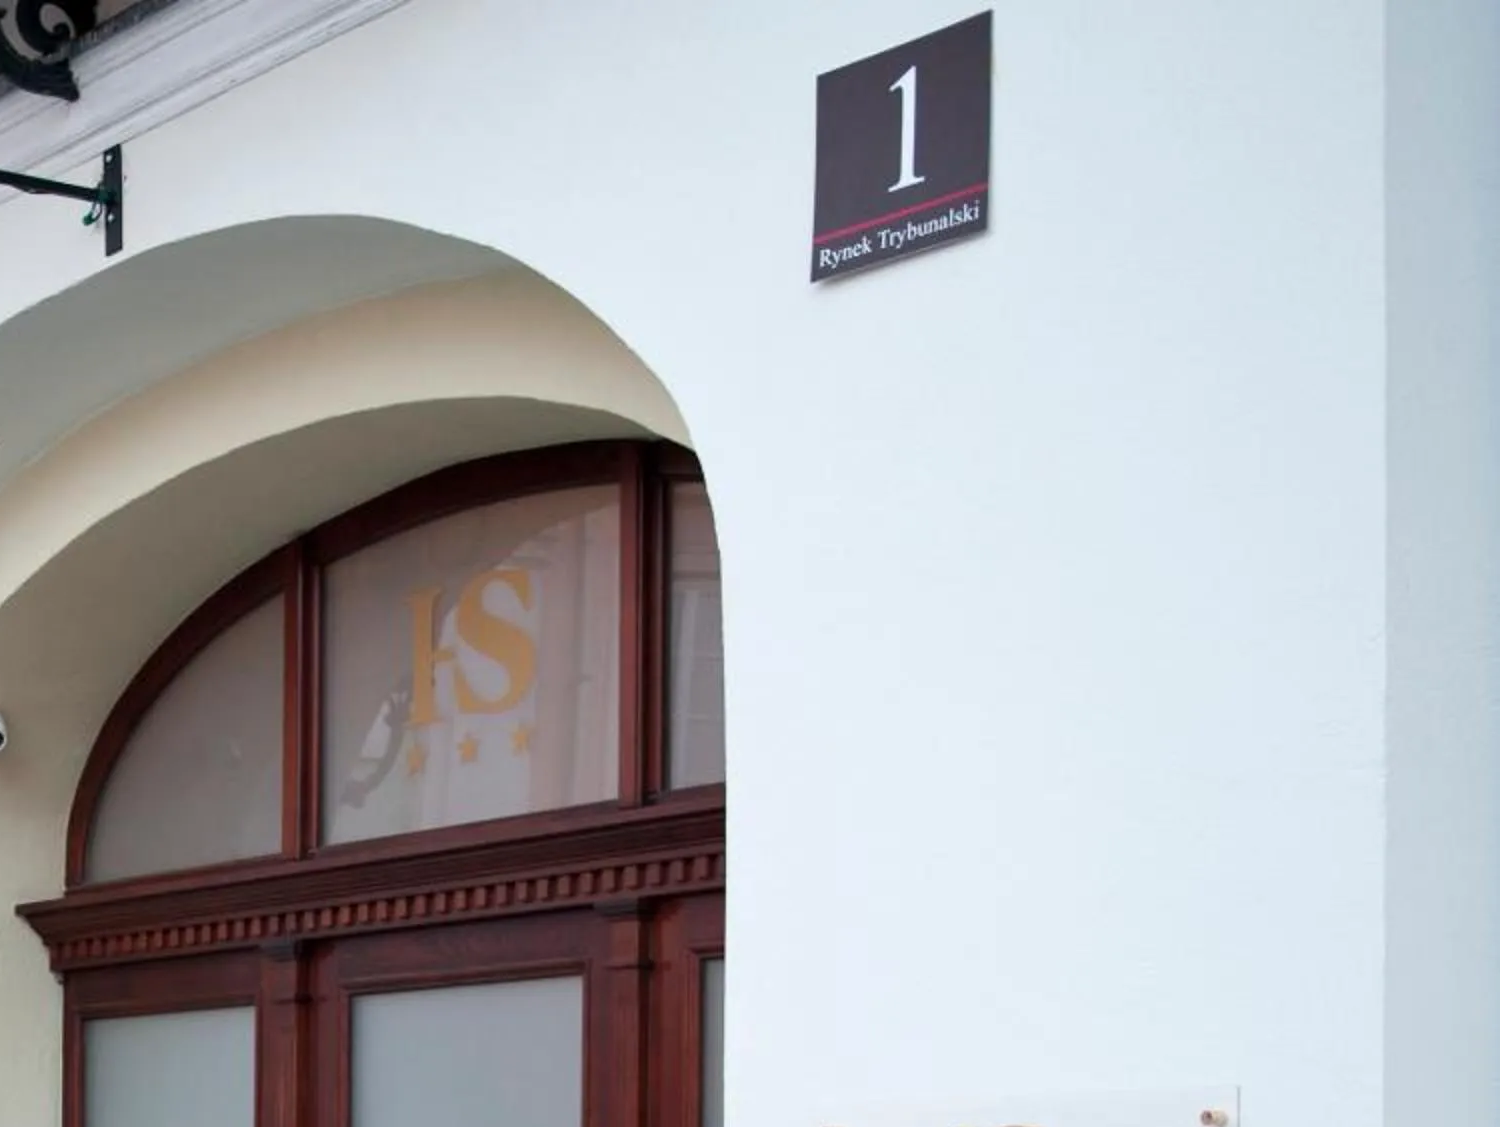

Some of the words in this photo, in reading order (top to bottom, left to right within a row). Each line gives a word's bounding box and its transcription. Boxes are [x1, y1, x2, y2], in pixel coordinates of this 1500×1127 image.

[888, 65, 925, 193] 1
[818, 236, 873, 269] Rynek
[877, 200, 981, 249] Trybunalski
